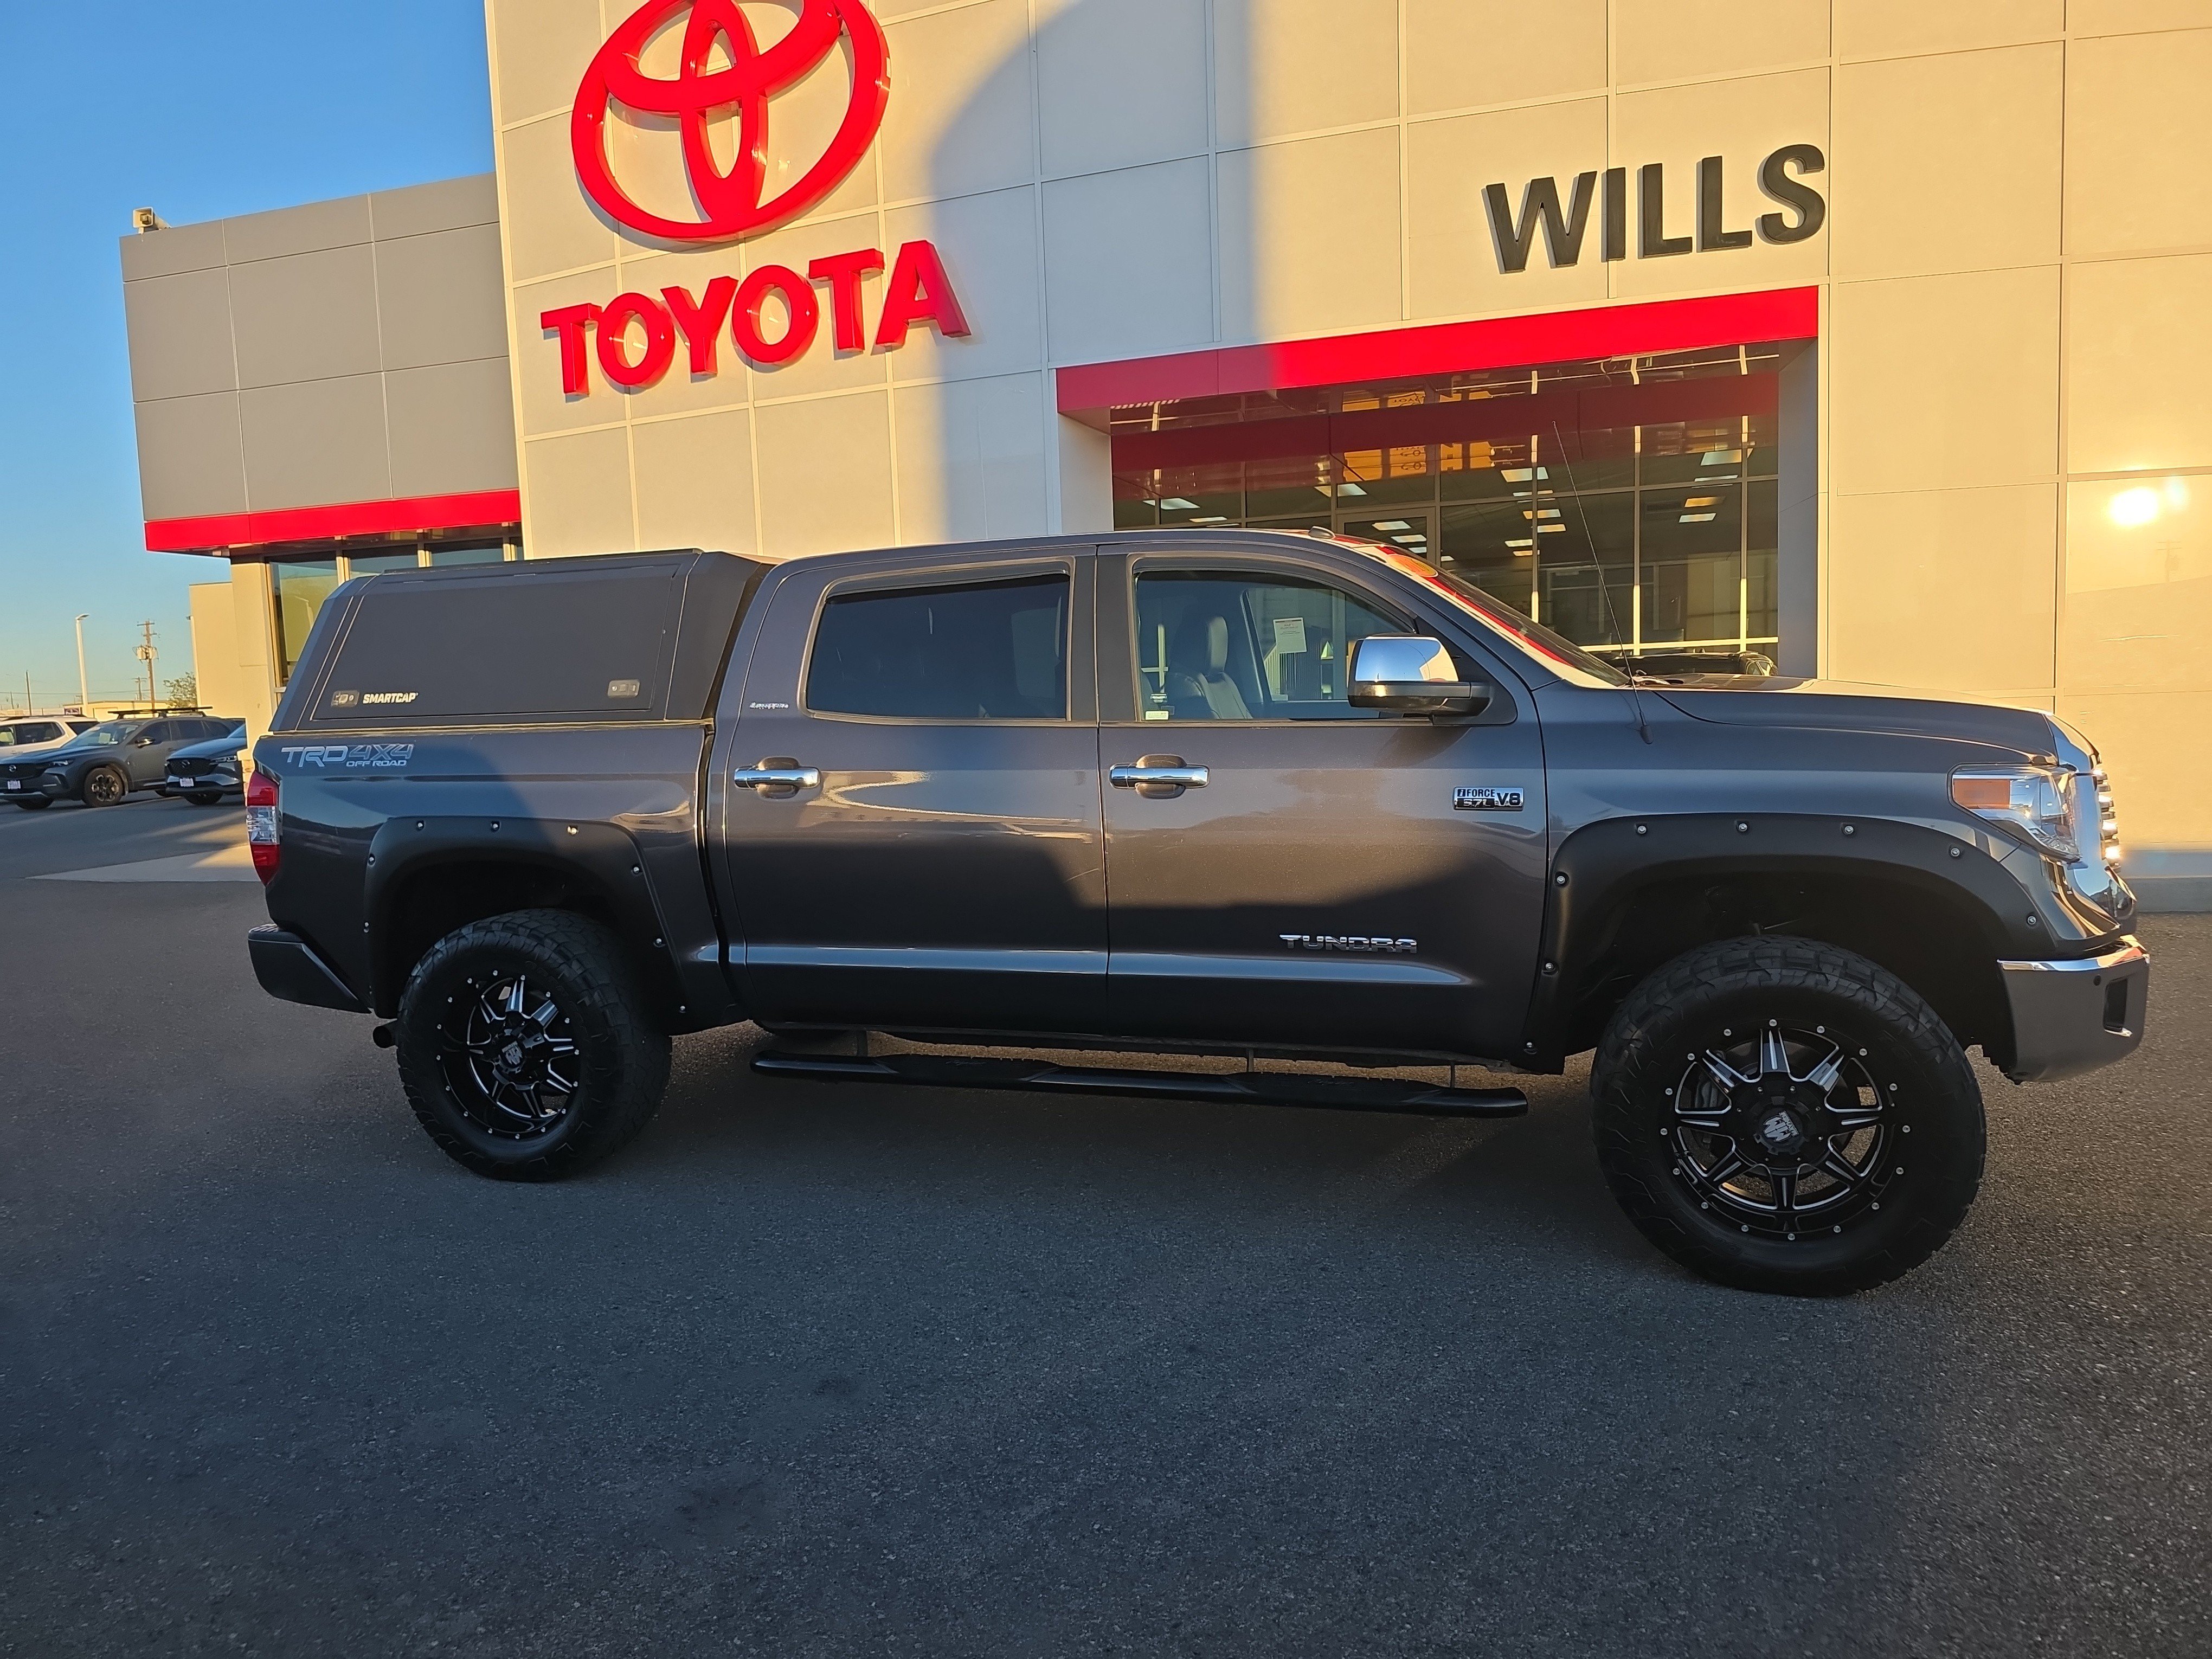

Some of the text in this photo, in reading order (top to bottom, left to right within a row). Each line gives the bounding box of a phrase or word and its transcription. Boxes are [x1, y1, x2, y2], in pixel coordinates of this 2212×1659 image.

[1483, 144, 1826, 274] WILLS
[541, 239, 972, 396] TOYOTA
[362, 692, 416, 704] SMARTCAP
[281, 745, 349, 768] TRD
[1496, 792, 1521, 806] V8
[1279, 934, 1417, 954] TUNDRA
